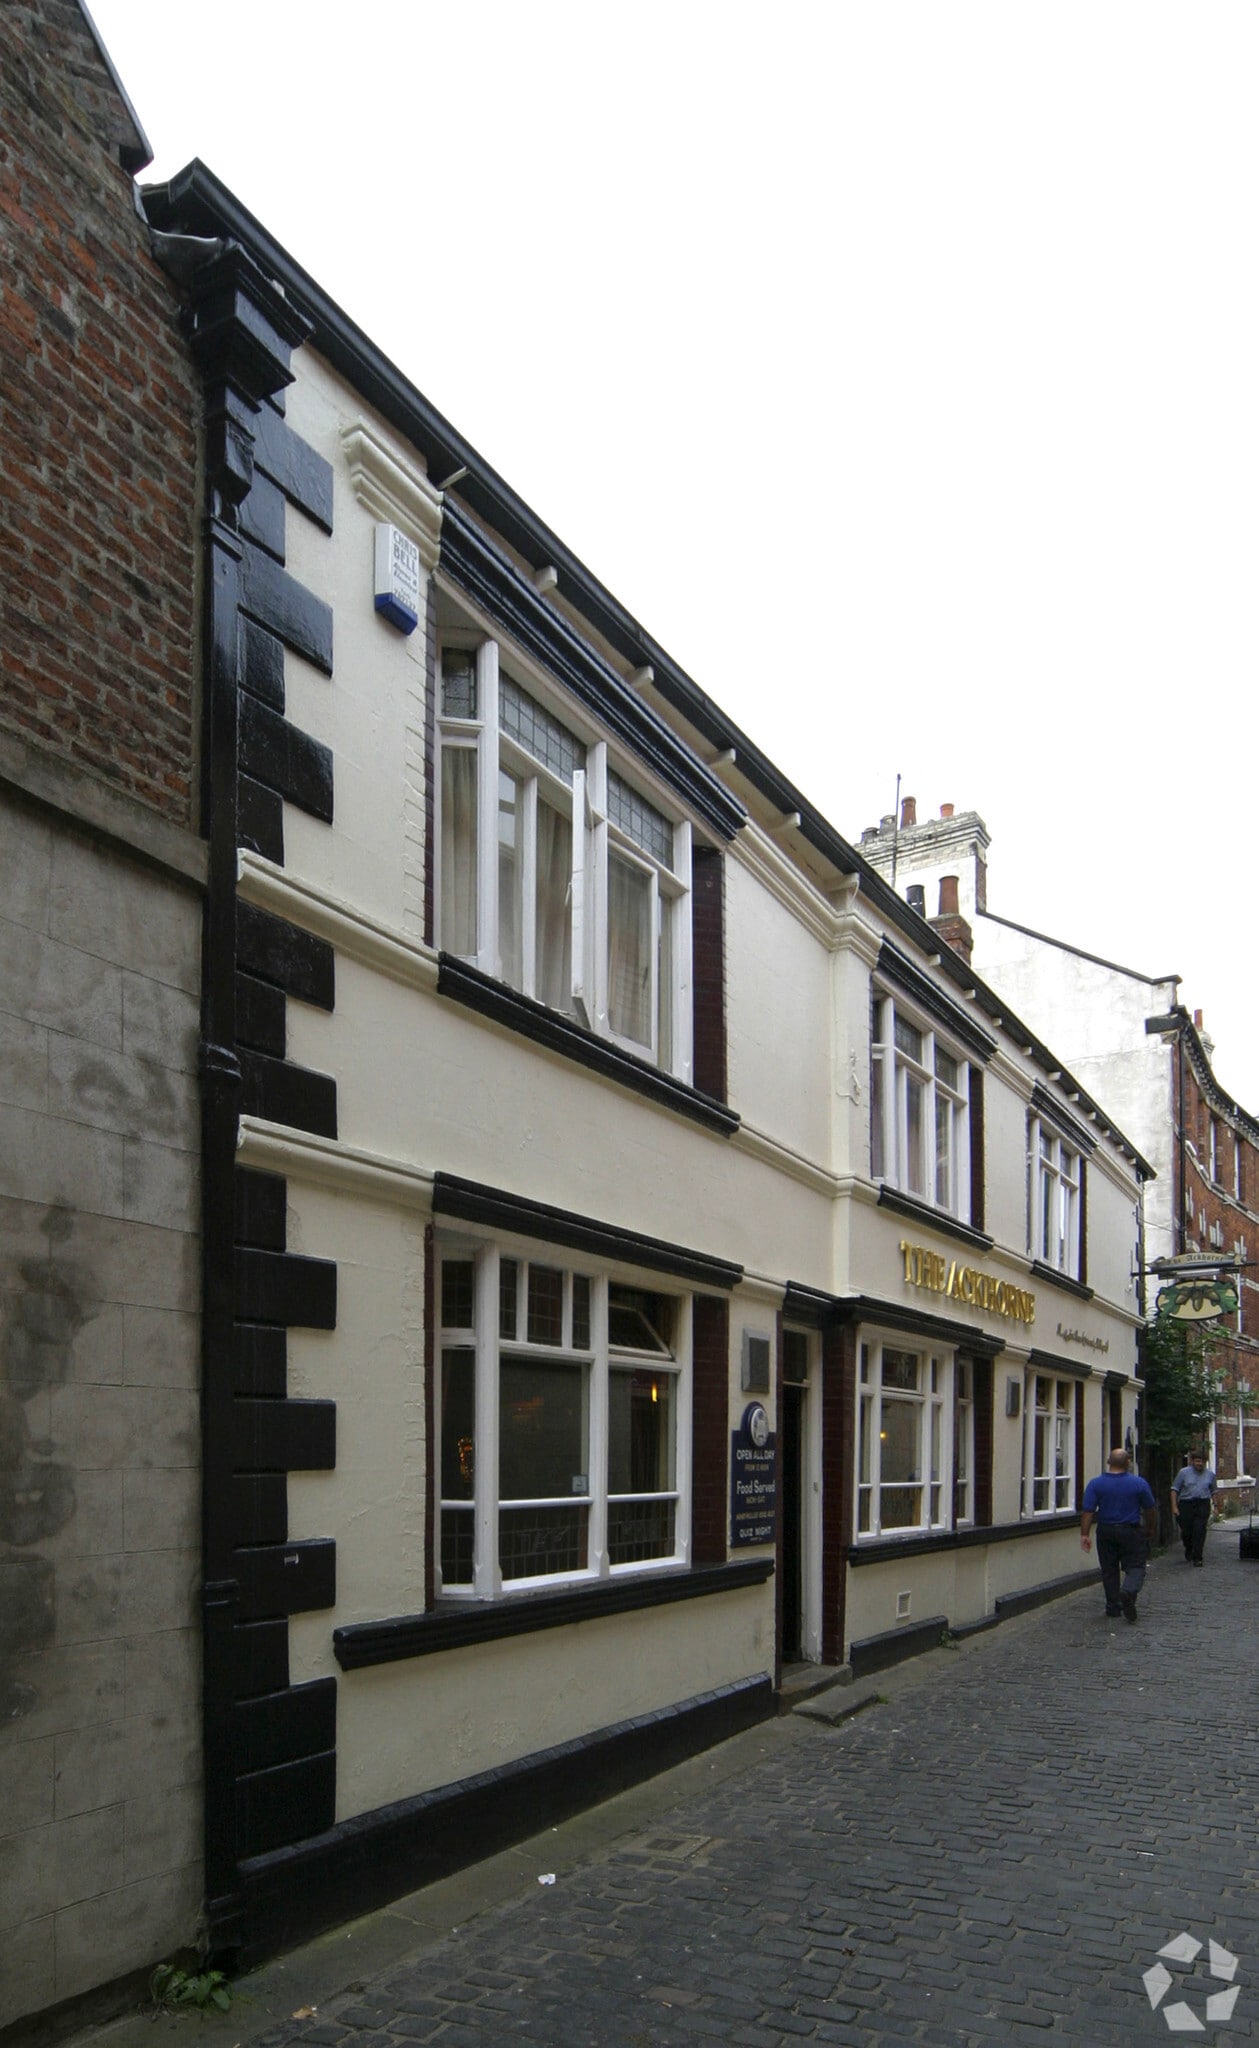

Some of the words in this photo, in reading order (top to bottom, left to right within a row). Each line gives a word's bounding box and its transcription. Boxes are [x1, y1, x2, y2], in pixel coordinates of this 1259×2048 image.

[394, 544, 417, 576] BELL
[900, 1240, 945, 1294] THE
[945, 1260, 1036, 1325] ACKHORNE
[736, 1449, 752, 1461] OPEN
[753, 1449, 764, 1460] ALL
[764, 1449, 776, 1460] DAY
[736, 1480, 753, 1495] Food
[753, 1479, 776, 1494] Served
[739, 1528, 753, 1538] QUIZ
[754, 1526, 772, 1536] NIGHT
